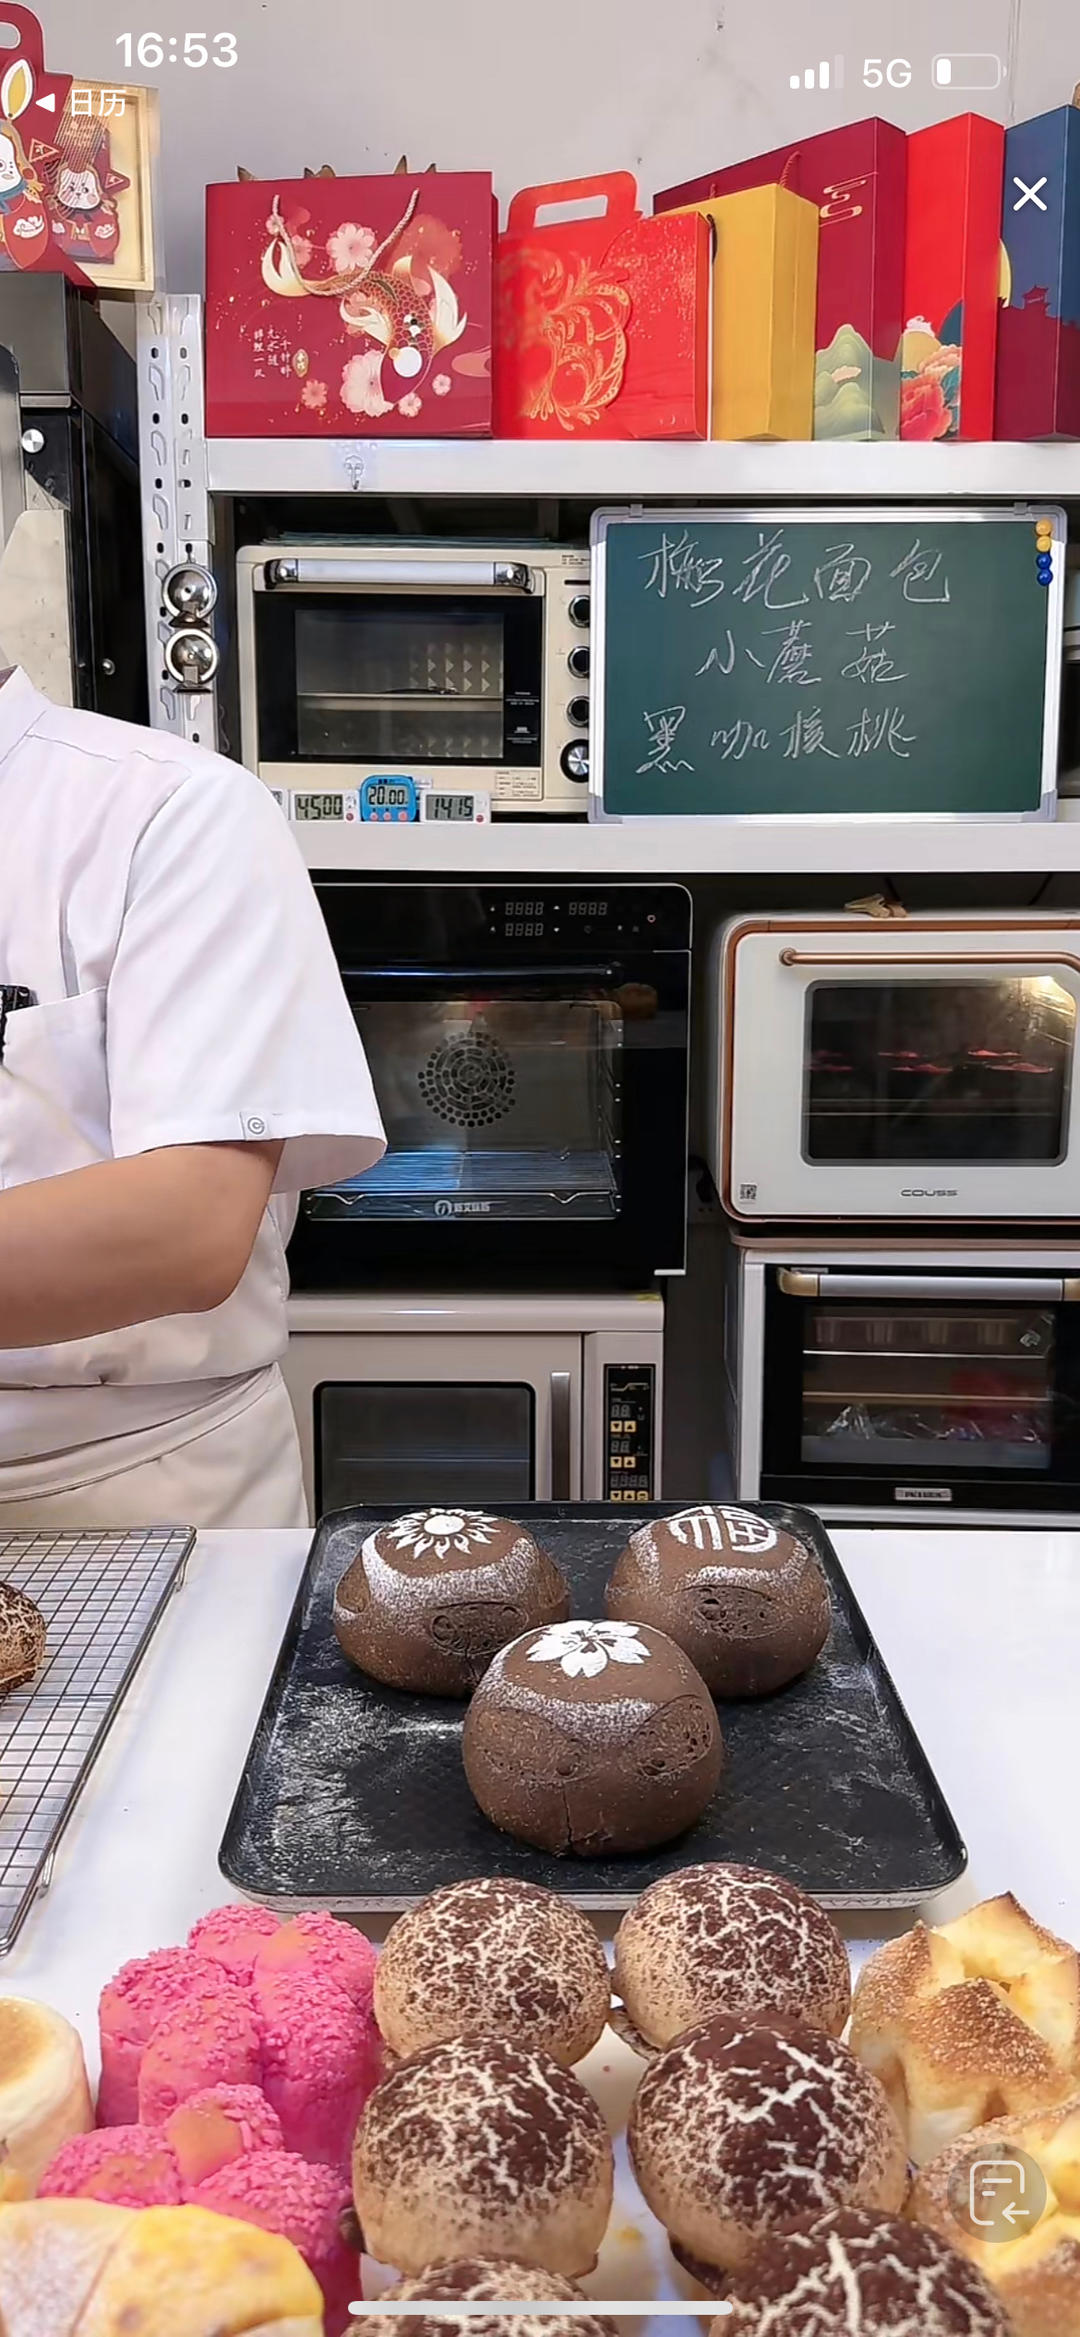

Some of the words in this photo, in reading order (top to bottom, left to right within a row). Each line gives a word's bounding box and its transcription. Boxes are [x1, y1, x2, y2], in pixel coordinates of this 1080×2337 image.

[695, 619, 911, 685] 小蘑菇
[636, 704, 916, 774] 黑咖核桃
